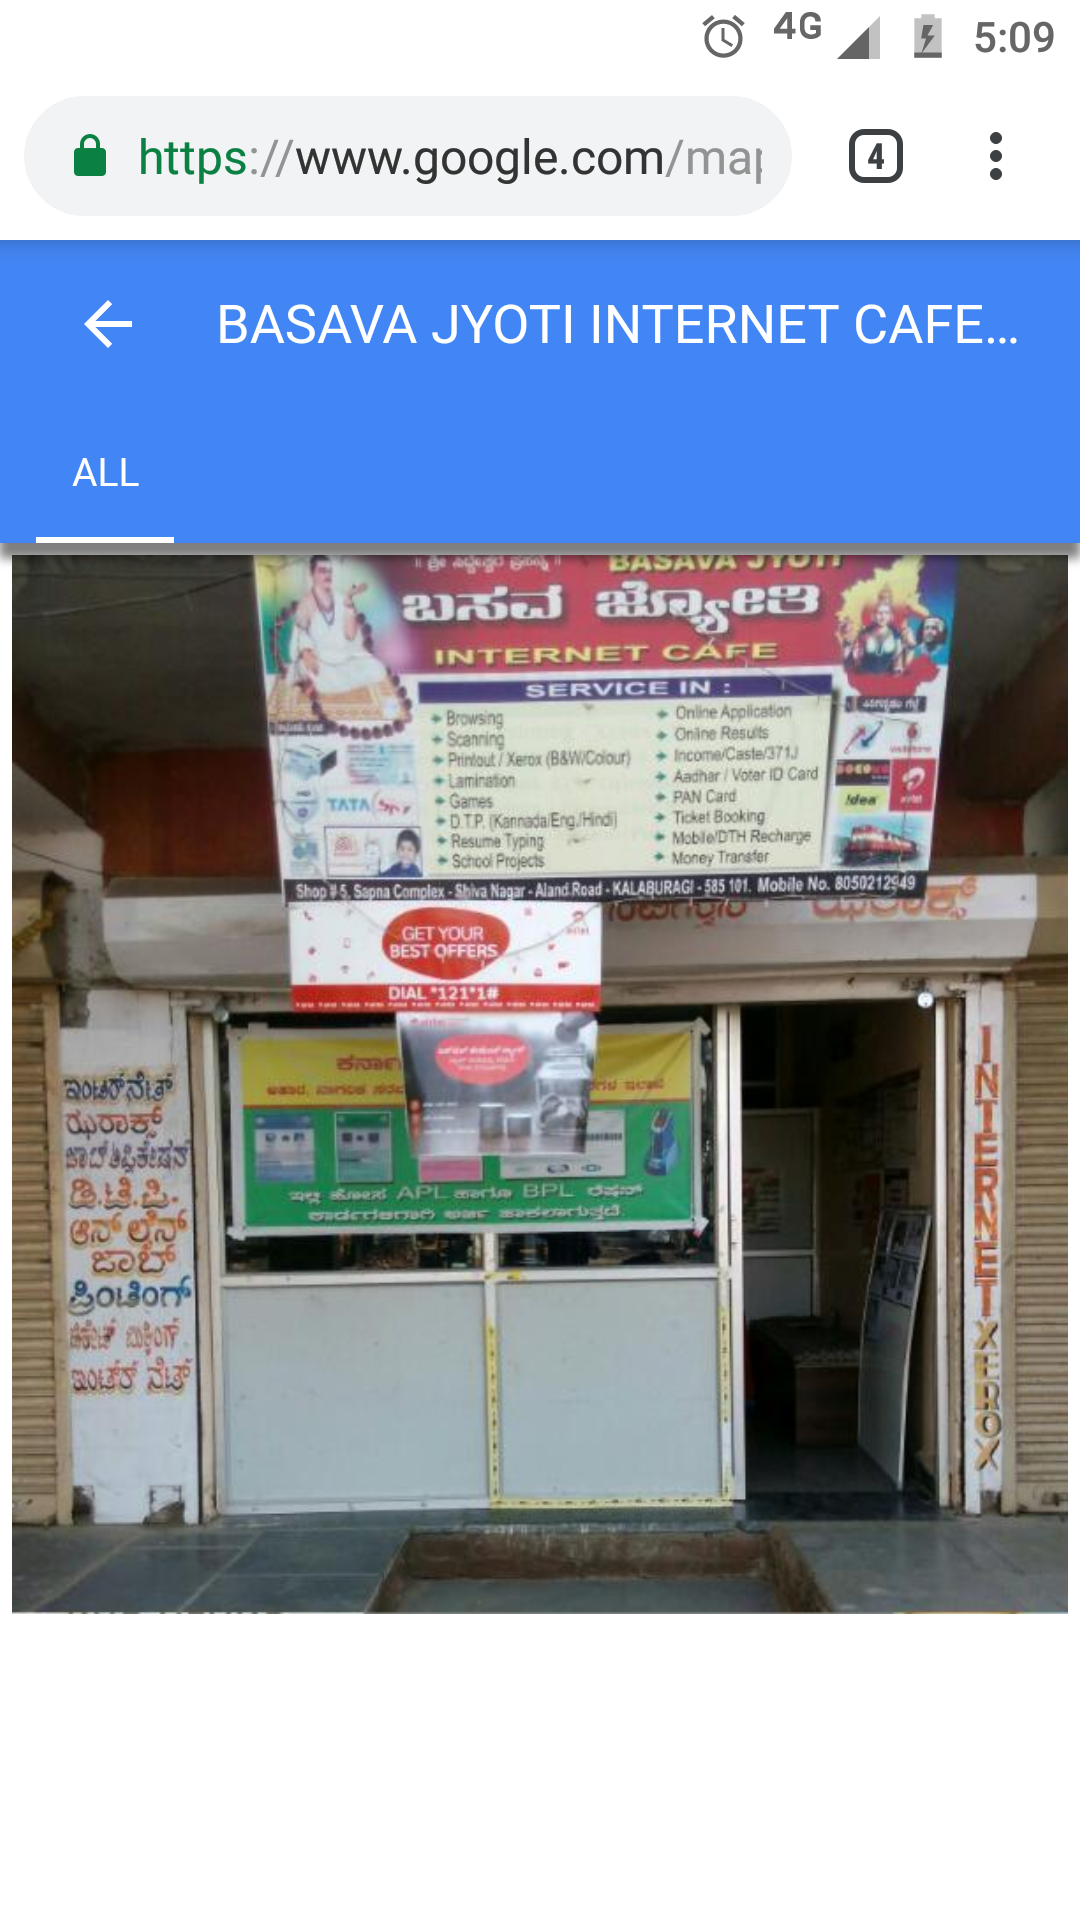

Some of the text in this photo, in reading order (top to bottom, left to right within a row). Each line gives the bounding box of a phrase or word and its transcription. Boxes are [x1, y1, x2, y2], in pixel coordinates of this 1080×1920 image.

[773, 12, 822, 39] 4G
[974, 21, 1055, 53] 5:09
[867, 143, 885, 170] 4
[219, 304, 418, 345] BASAVA
[431, 304, 572, 345] JYOTI
[592, 304, 840, 345] INTERNET
[71, 458, 140, 487] ALL
[608, 555, 844, 573] BASAVA JYOTI
[402, 579, 821, 635] ಬಸವ ಜ್ಯೋತಿ
[434, 642, 779, 666] INTERNET CAFE
[525, 681, 670, 699] SERVICE
[679, 680, 712, 695] IN
[446, 709, 504, 730] Browsing
[675, 704, 793, 722] Online Application
[447, 731, 505, 750] Scanning
[674, 726, 770, 741] Online Results
[448, 751, 496, 768] Printout
[506, 752, 542, 767] Xerox
[546, 750, 632, 770] (B&W/Colour)
[674, 745, 799, 763] Income/Caste/371J
[449, 773, 516, 789] Lamination
[673, 768, 721, 784] Aadhar
[731, 768, 766, 782] Voter
[769, 767, 784, 782] ID
[787, 766, 819, 781] Card
[327, 797, 370, 812] TATA
[449, 793, 494, 809] Games
[673, 789, 737, 804] PAN Card
[450, 814, 486, 830] D.T.P.
[673, 809, 766, 826] Ticket Booking
[451, 832, 545, 851] Resume Typing
[672, 829, 812, 846] Mobile/DTH Recharge
[452, 853, 546, 871] School Projects
[672, 850, 770, 867] Money Transfer
[296, 883, 327, 900] Shop
[353, 883, 390, 900] Sapna
[393, 883, 445, 900] Complex
[455, 883, 488, 898] Shiva
[490, 882, 526, 900] Nagar
[612, 879, 695, 897] KALABURAGI
[704, 878, 726, 893] 585
[757, 877, 803, 893] Mobile
[807, 875, 831, 891] No.
[834, 874, 916, 891] 8050212949
[401, 926, 484, 941] GET YOUR
[390, 943, 499, 959] BEST OFFERS
[388, 986, 426, 1000] DIAL
[65, 1105, 163, 1141] ಝರಾಕ್ಸ್
[396, 1184, 448, 1200] APL
[522, 1183, 576, 1198] BPL
[973, 1024, 1002, 1472] INTERNET XEROX
[68, 1275, 192, 1317] ಪ್ರಿಂಟಿಂಗ್
